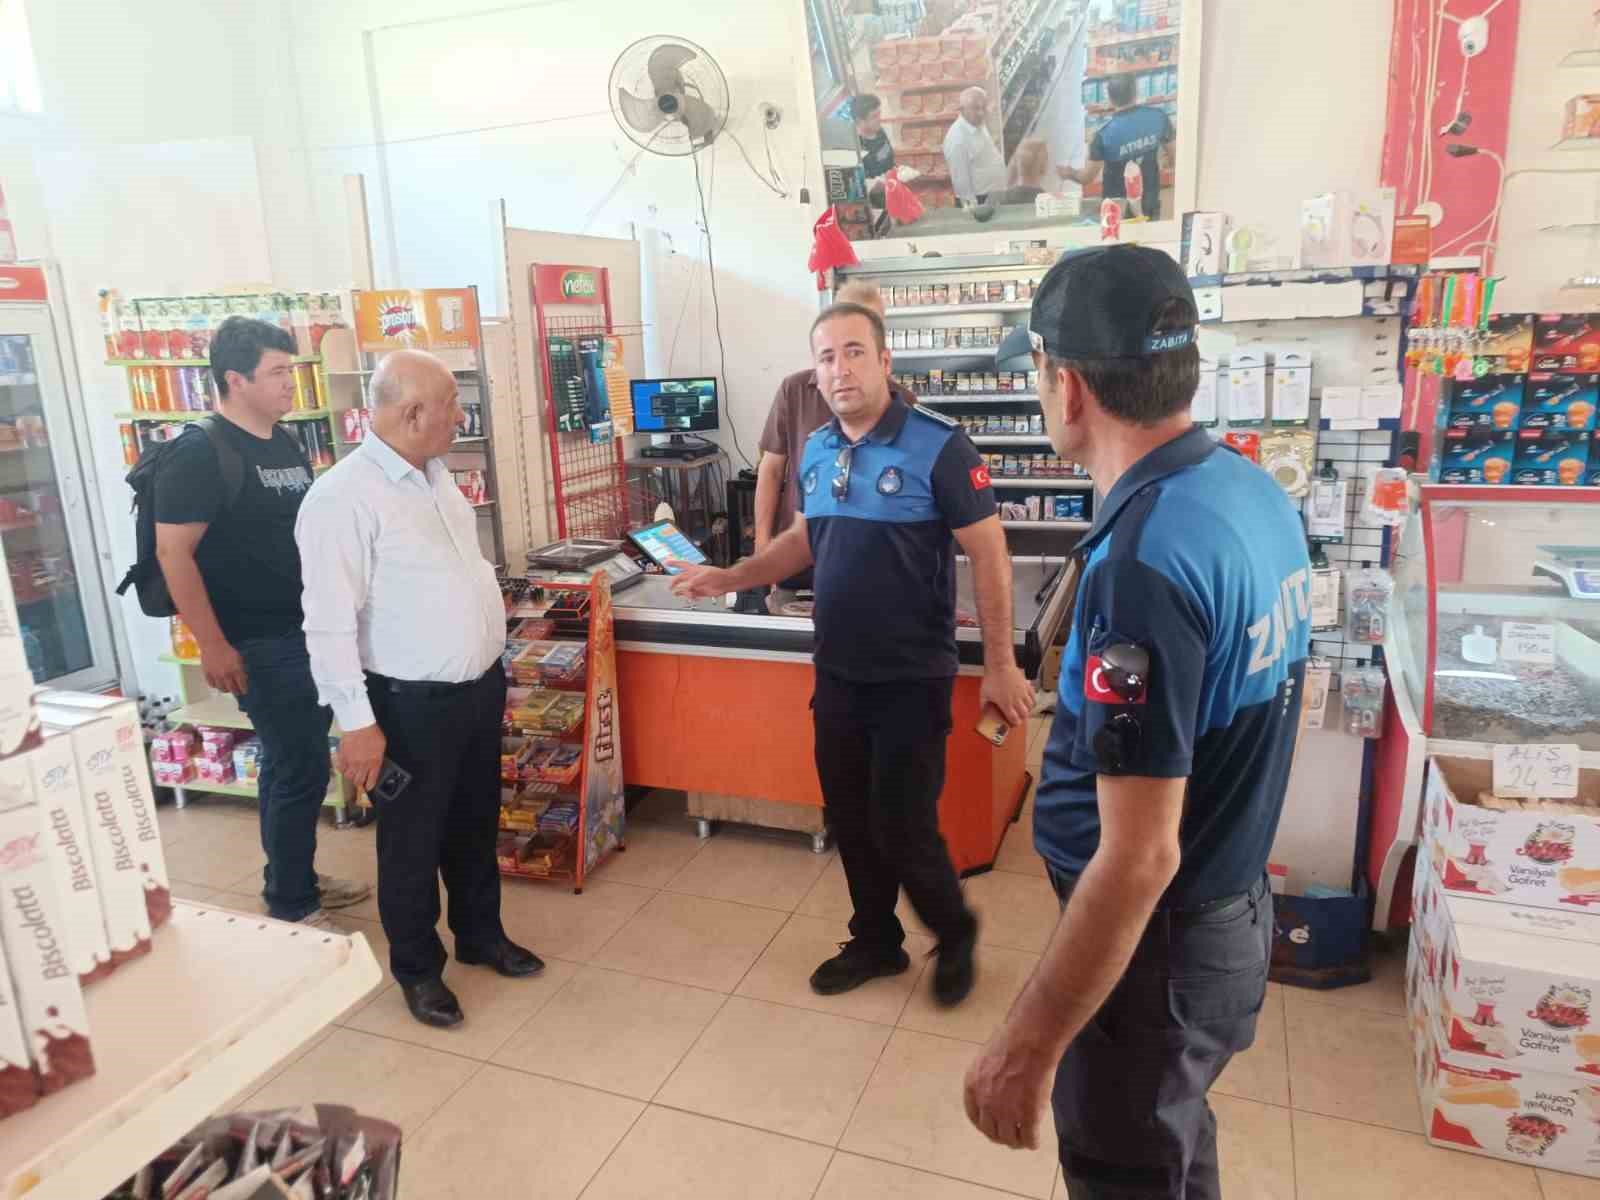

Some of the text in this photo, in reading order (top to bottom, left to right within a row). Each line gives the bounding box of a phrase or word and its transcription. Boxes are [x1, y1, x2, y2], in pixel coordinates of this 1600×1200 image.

[49, 808, 94, 892] Biscolata
[94, 791, 135, 871] Biscolata
[1507, 874, 1548, 887] Gofret
[11, 882, 70, 981] Biscolata
[1520, 1038, 1561, 1053] Gofret
[1535, 1090, 1576, 1107] Gofret
